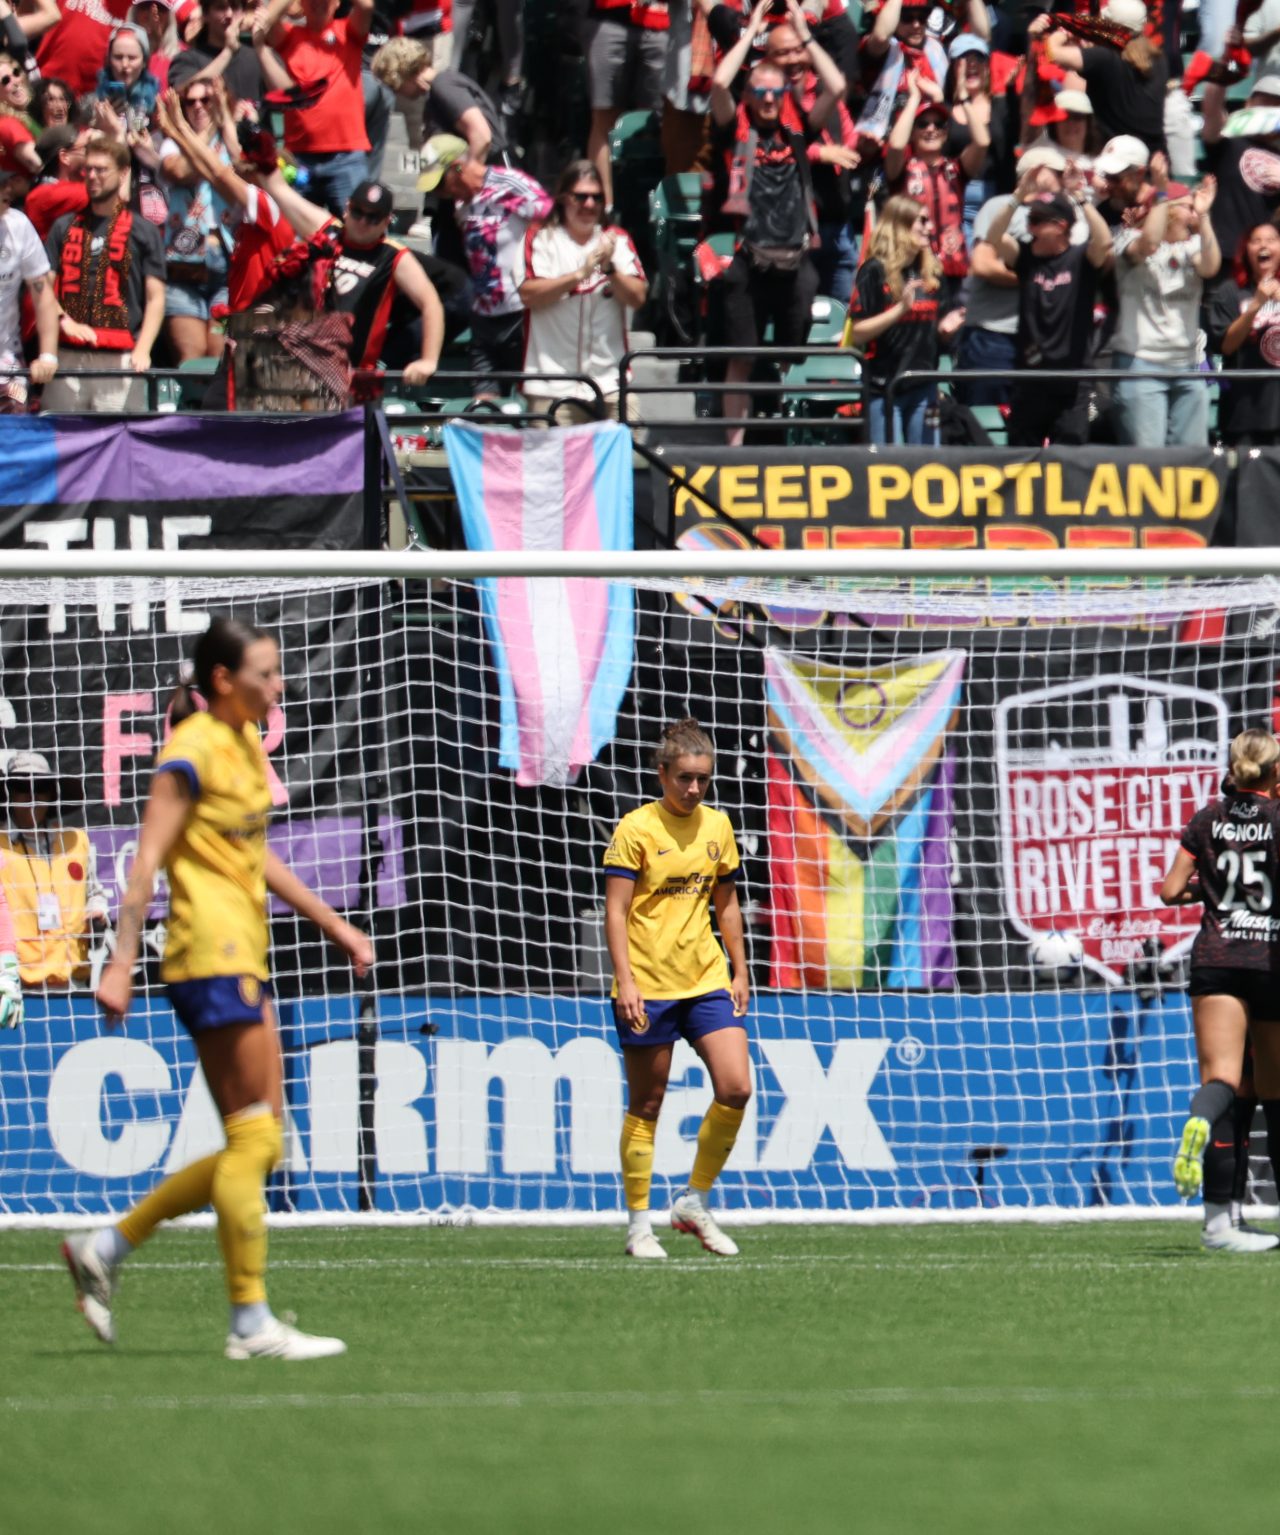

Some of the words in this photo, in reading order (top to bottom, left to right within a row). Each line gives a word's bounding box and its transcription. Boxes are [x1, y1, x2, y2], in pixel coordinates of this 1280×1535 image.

[670, 464, 853, 519] KEEP
[867, 462, 1220, 519] PORTLAND
[24, 514, 212, 634] THE
[1014, 774, 1119, 840] ROSE
[1126, 773, 1214, 831] CITY
[1211, 820, 1274, 842] VIGNOLA
[1018, 838, 1181, 913] RIVETE
[1216, 849, 1273, 911] 25
